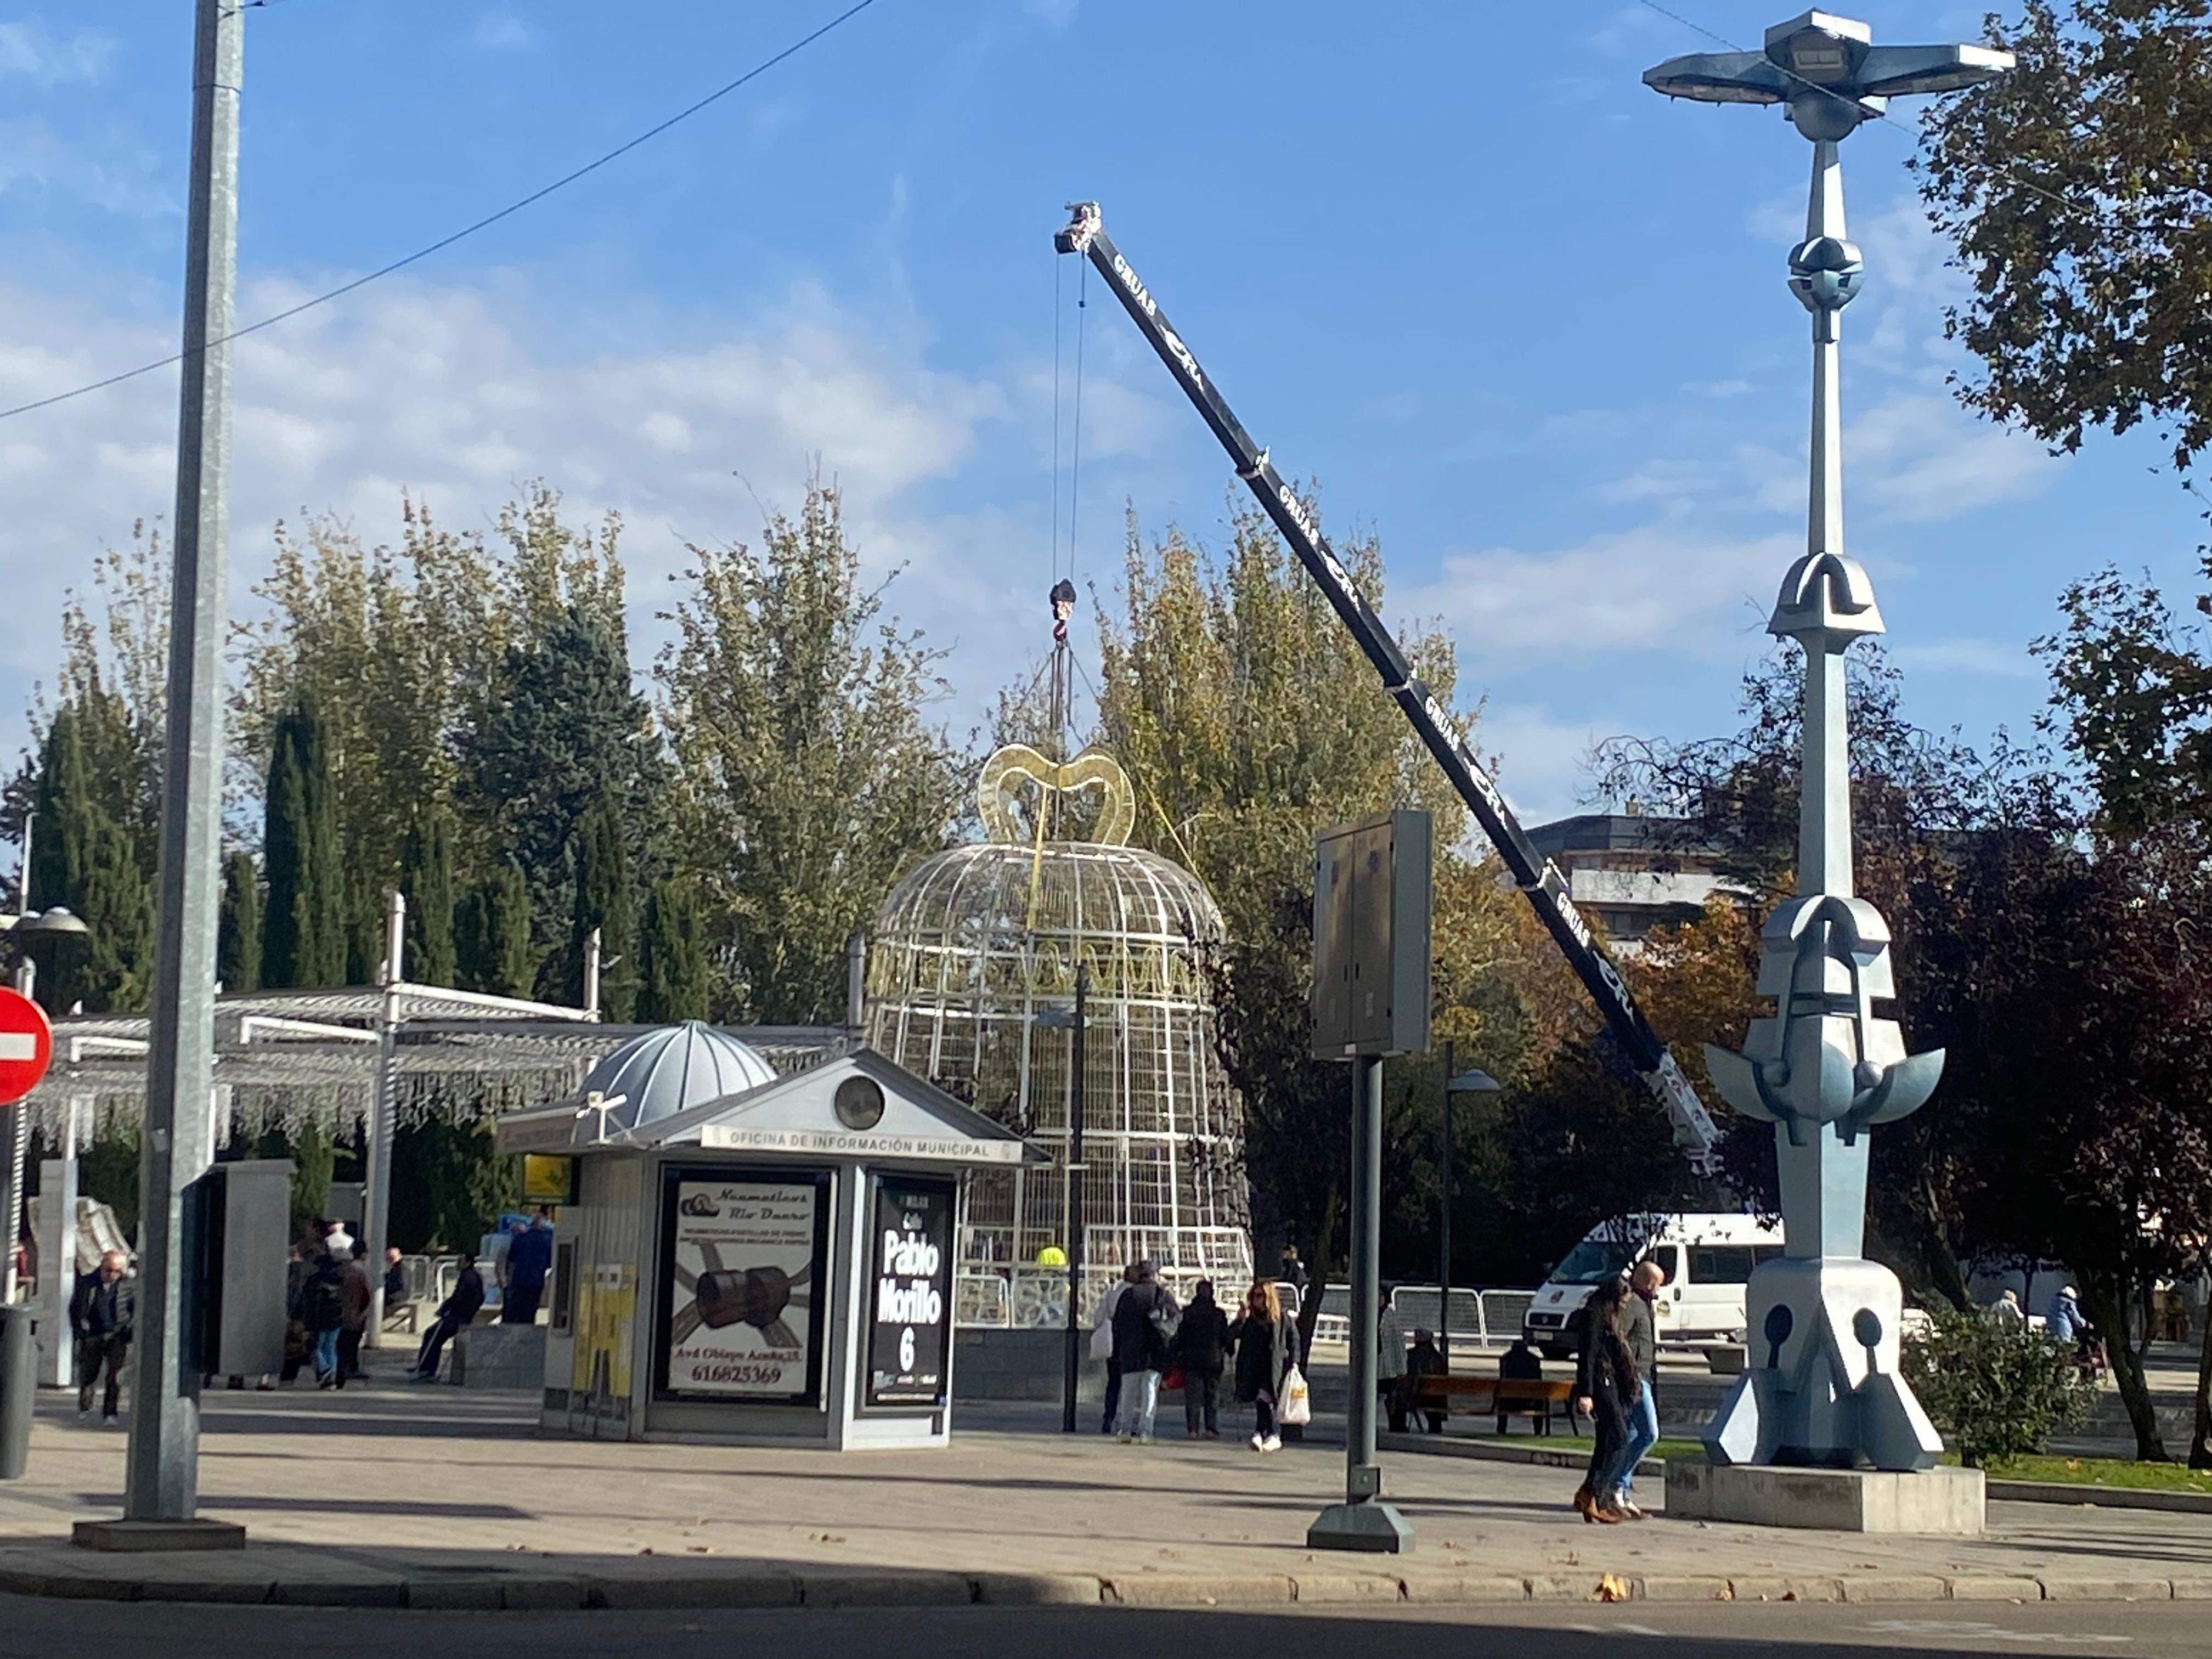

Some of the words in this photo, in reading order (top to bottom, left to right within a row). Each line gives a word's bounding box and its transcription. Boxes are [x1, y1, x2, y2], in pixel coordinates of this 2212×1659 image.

[730, 1132, 786, 1146] OFICINA
[790, 1135, 808, 1147] DE
[812, 1136, 913, 1153] INFORMACIÓN
[917, 1141, 990, 1157] MUNICIPAL
[883, 1229, 939, 1277] Pablo
[878, 1277, 941, 1325] Morillo
[900, 1325, 915, 1372] 6
